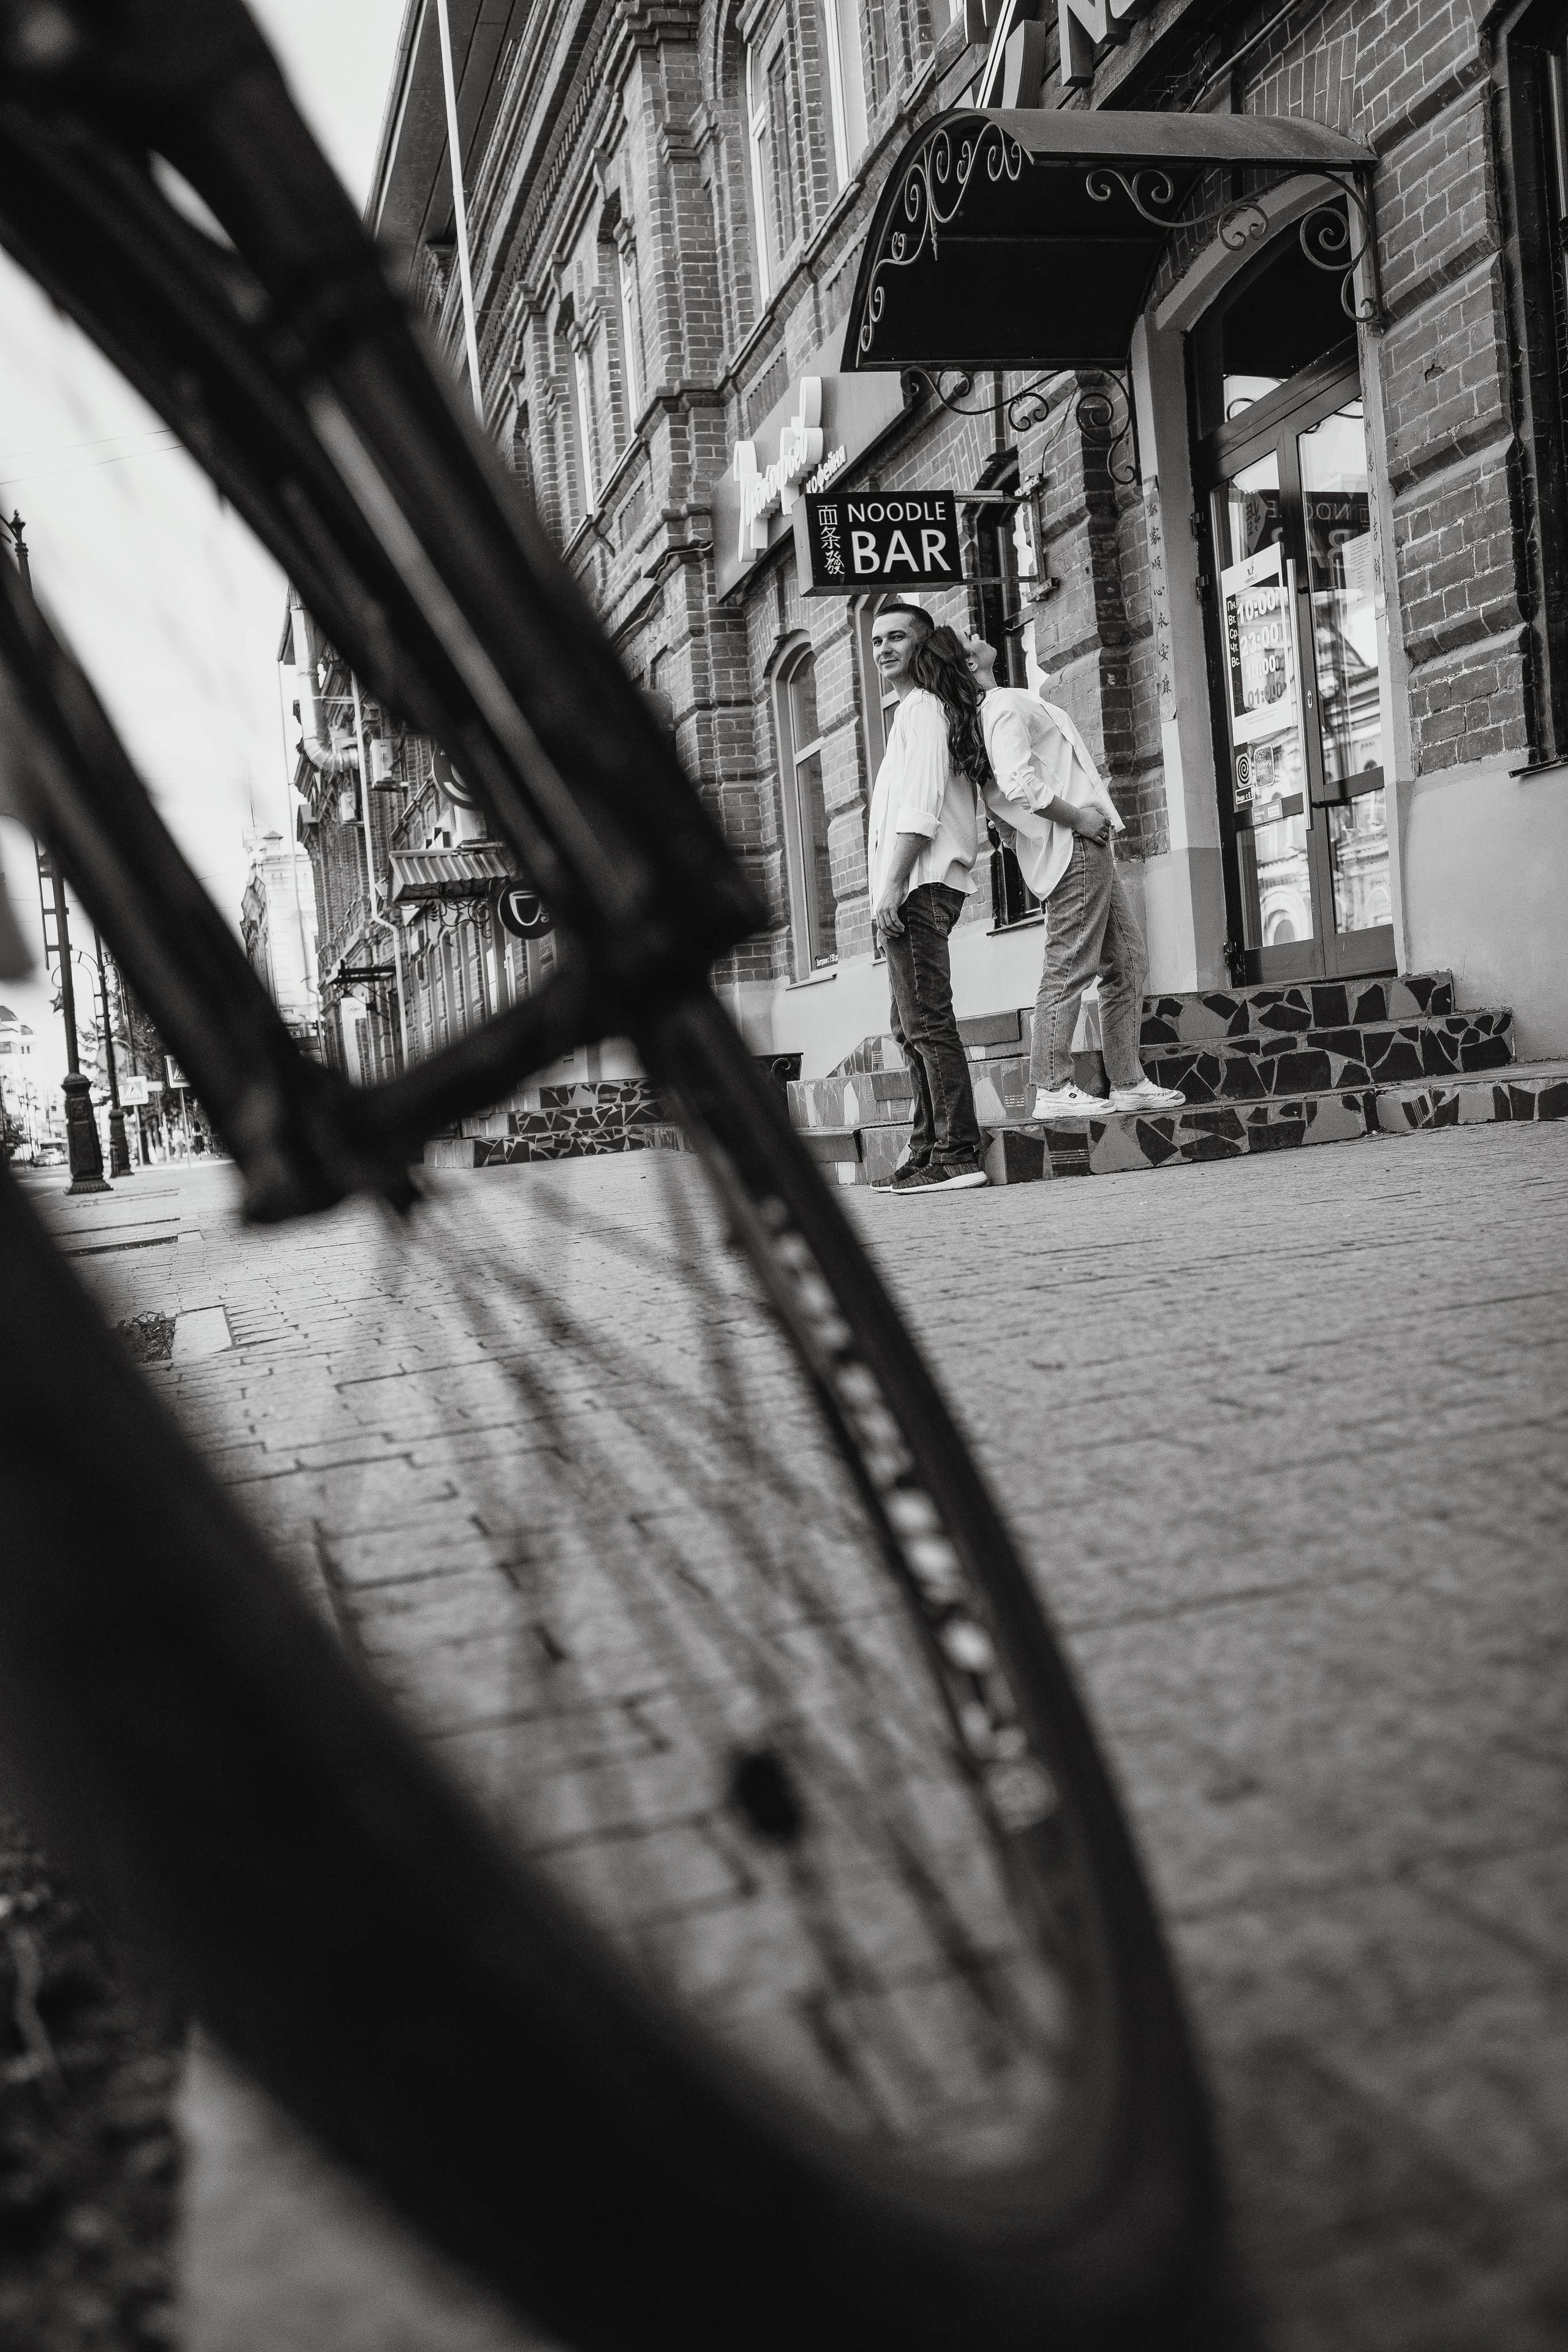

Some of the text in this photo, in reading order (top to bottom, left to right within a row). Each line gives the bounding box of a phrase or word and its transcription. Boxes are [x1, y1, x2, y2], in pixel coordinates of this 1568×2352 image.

[847, 502, 946, 522] NOODLE
[851, 529, 952, 574] BAR
[1227, 600, 1237, 611] Пн.
[1237, 589, 1276, 624] 10:00
[1228, 615, 1237, 625] Вт.
[1229, 628, 1239, 640] Ср.
[1240, 622, 1279, 658] 23:00
[1230, 643, 1239, 652] Чт.
[1231, 657, 1241, 668] Вс.
[1246, 655, 1276, 681] 10:00
